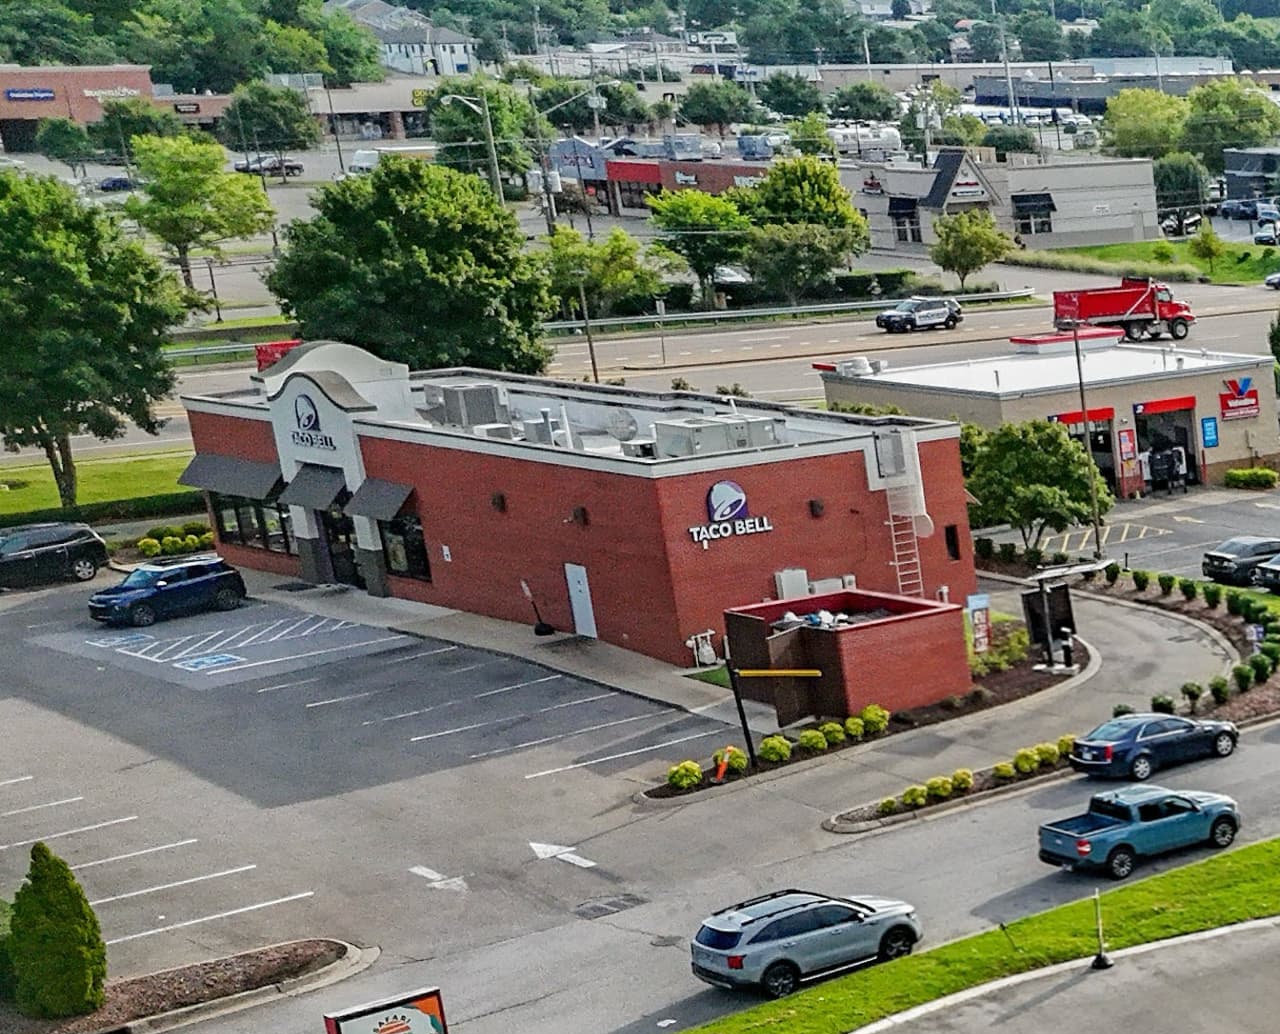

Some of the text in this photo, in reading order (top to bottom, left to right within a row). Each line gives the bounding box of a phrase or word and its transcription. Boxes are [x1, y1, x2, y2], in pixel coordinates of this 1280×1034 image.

[689, 516, 773, 542] TACO BELL
[373, 1014, 412, 1034] SAFARI
